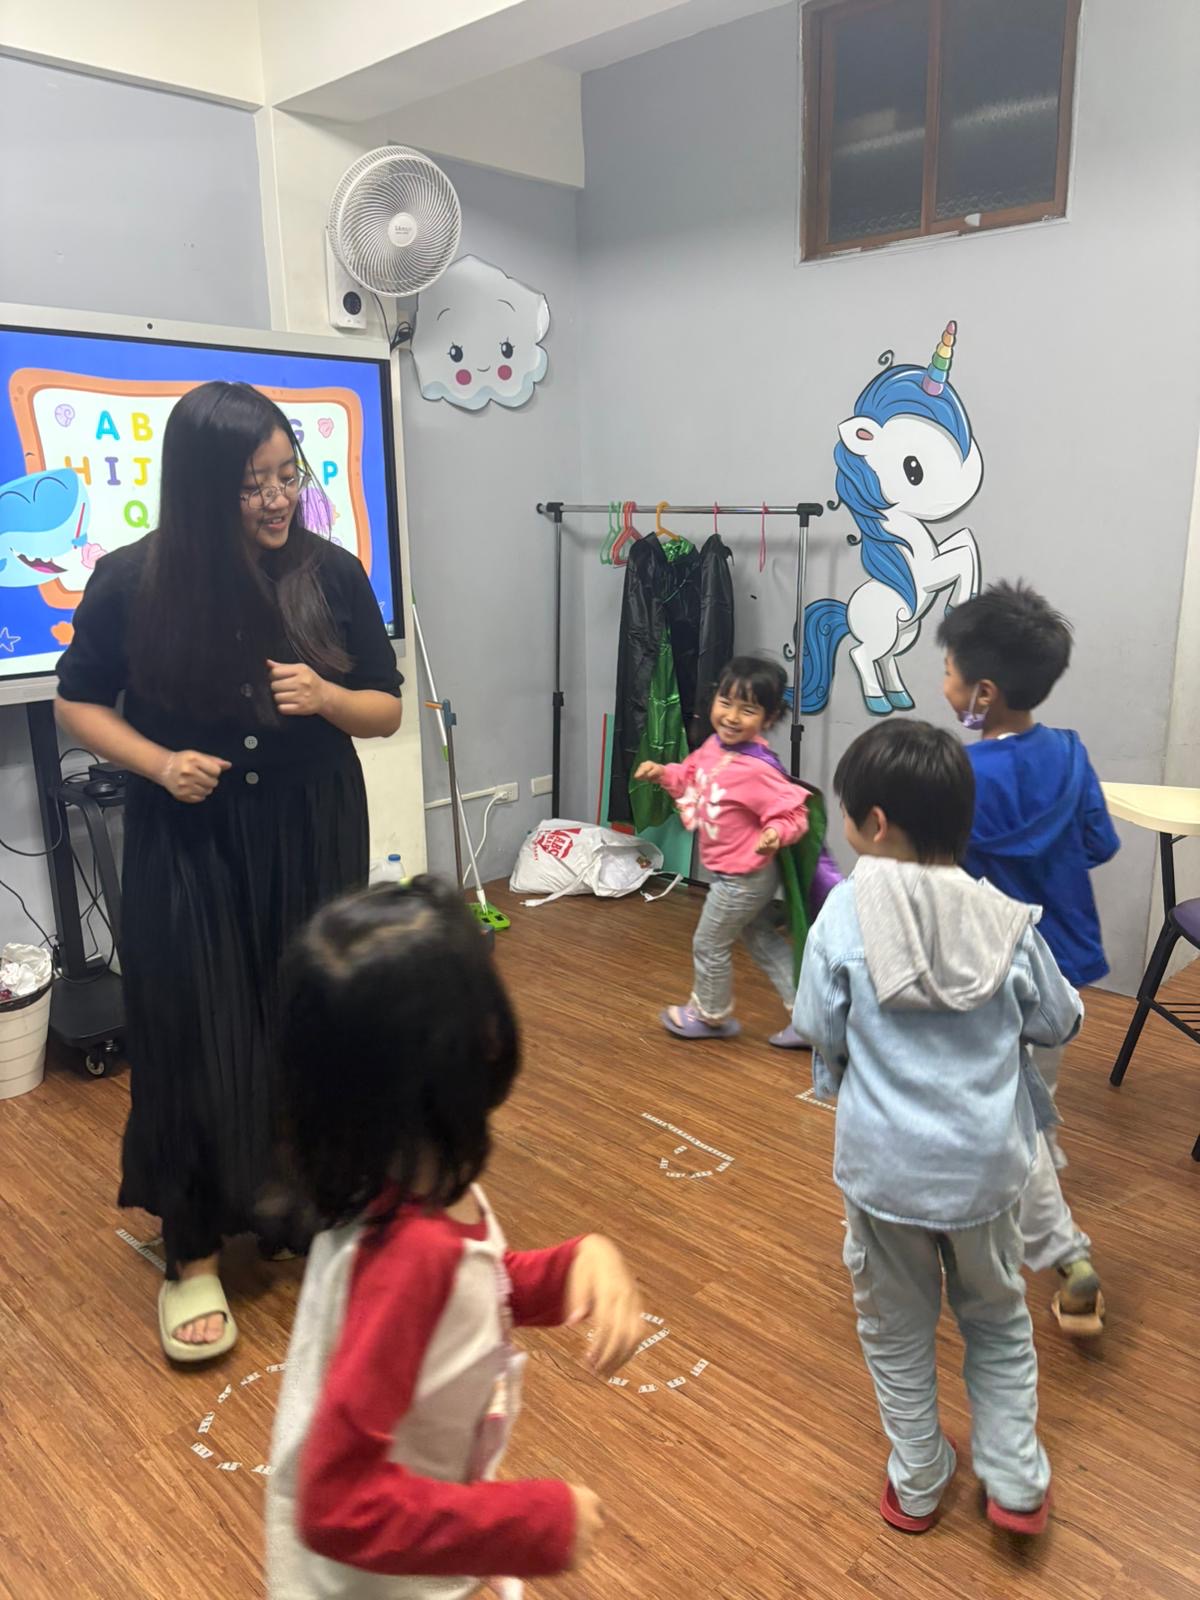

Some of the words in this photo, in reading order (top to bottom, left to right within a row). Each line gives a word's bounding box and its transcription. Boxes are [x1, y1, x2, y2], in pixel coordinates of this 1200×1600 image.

[96, 410, 120, 440] A
[131, 412, 153, 441] B
[104, 456, 121, 485] I
[133, 457, 152, 485] J
[322, 460, 338, 486] P
[124, 500, 150, 528] Q
